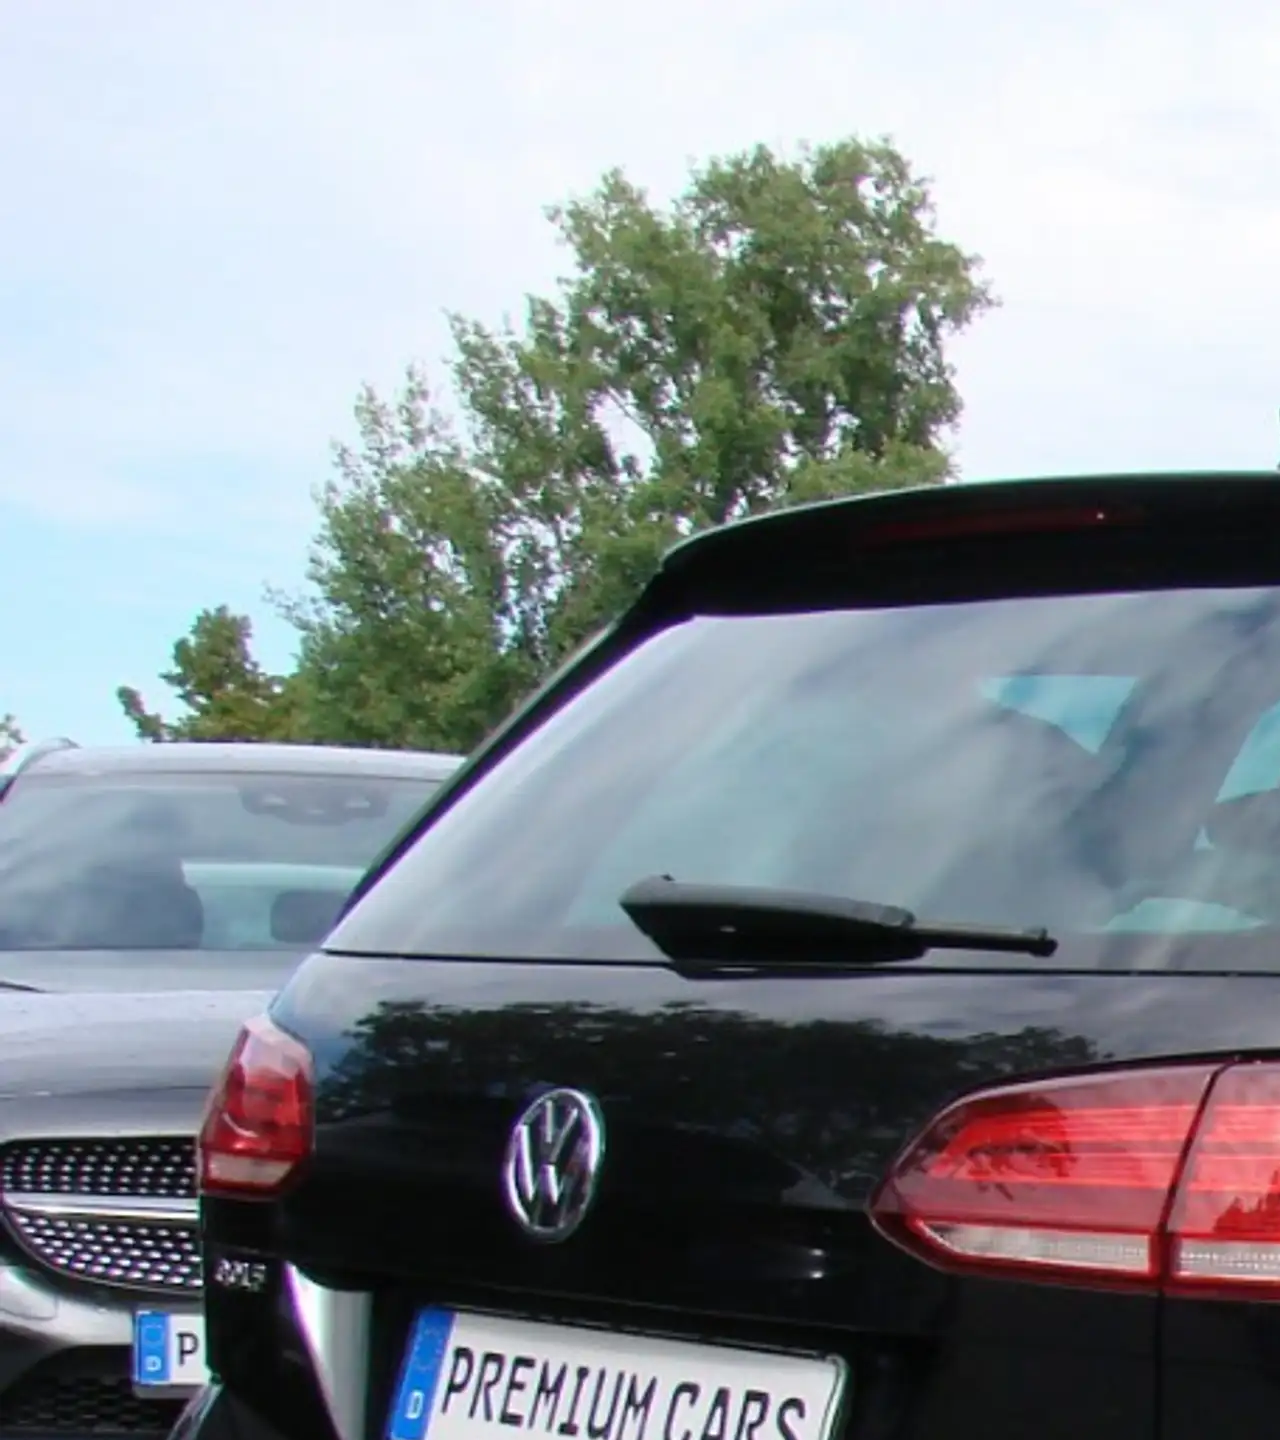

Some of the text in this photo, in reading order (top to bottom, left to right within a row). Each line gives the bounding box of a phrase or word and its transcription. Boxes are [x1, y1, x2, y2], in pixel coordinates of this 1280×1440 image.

[511, 1090, 601, 1236] VW
[176, 1332, 199, 1367] P
[404, 1390, 422, 1420] D
